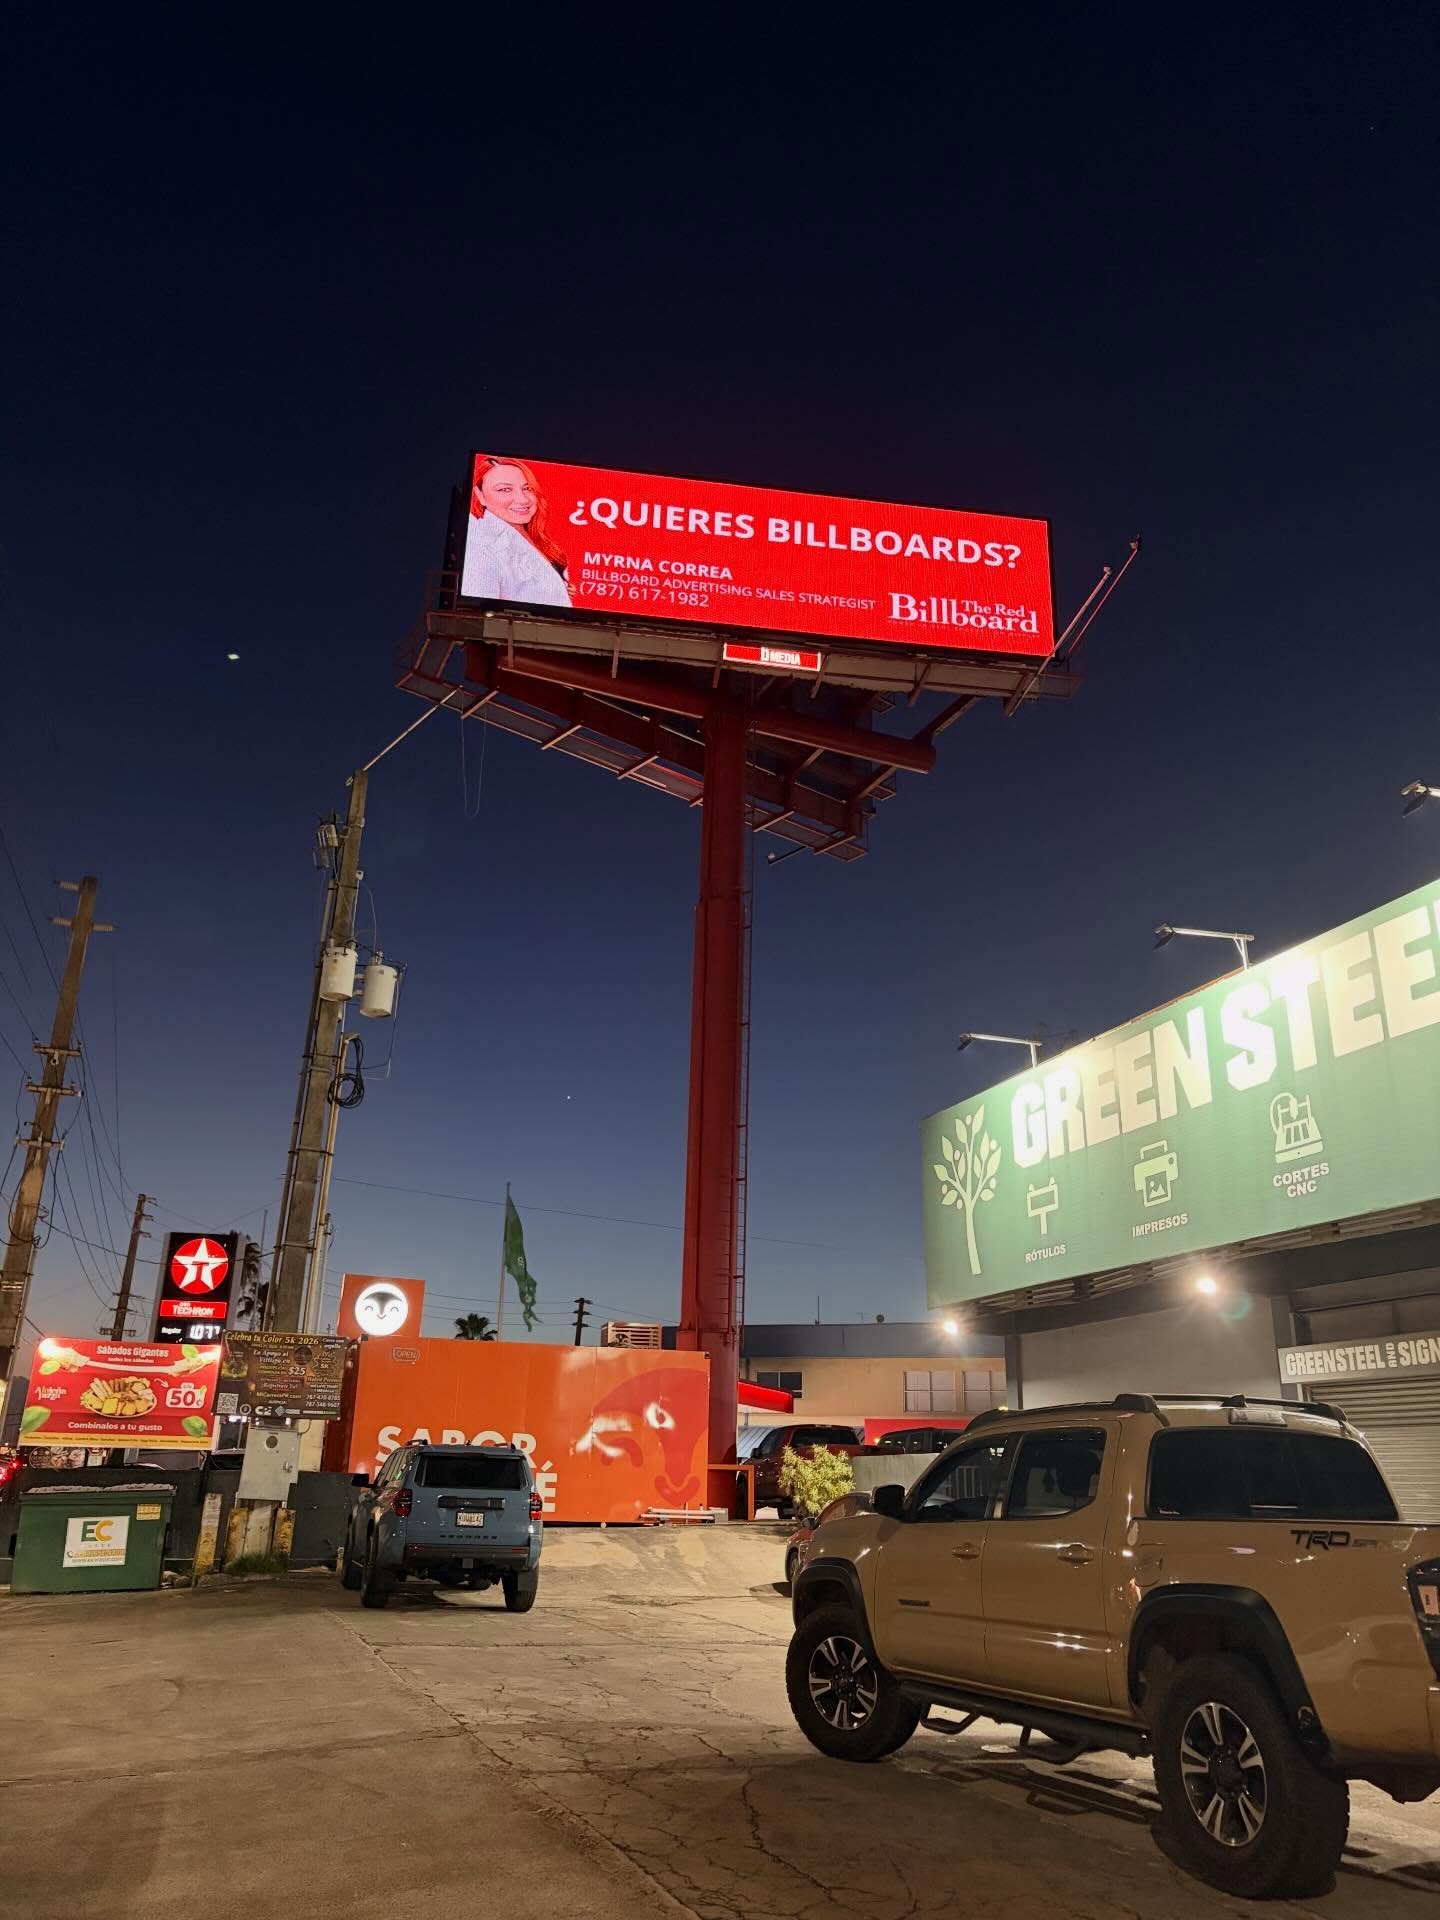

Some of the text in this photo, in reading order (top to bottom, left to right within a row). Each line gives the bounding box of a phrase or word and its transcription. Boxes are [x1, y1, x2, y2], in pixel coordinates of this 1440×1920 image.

[568, 497, 1021, 569] ¿QUIERES BILLBOARDS?
[584, 551, 733, 581] MYRNA CORREA
[579, 580, 710, 608] (787) 617-1982
[582, 568, 876, 610] BILLBOARD ADVERTISING SALES STRATEGIST
[888, 592, 1040, 634] Billboard
[961, 600, 1026, 618] The Red
[770, 650, 801, 666] MEDIA
[1010, 900, 1440, 1169] GREEN STEE
[1272, 1161, 1330, 1189] CORTES
[1286, 1179, 1318, 1199] CNC
[1131, 1212, 1189, 1239] IMPRESOS
[1024, 1243, 1067, 1264] RÓTULOS
[173, 1305, 216, 1317] TECHRON
[225, 1332, 252, 1342] Celebra
[253, 1333, 261, 1342] tu
[262, 1334, 282, 1344] Color
[298, 1337, 319, 1345] 2026
[133, 1347, 169, 1358] Gigantes
[396, 1350, 418, 1360] OPEN
[1285, 1344, 1386, 1376] GREENSTEEL
[1385, 1342, 1398, 1368] AND
[288, 1367, 306, 1376] $25
[127, 1422, 137, 1431] tu
[138, 1423, 163, 1433] gusto
[81, 1520, 114, 1542] EC
[1290, 1529, 1351, 1550] TRD
